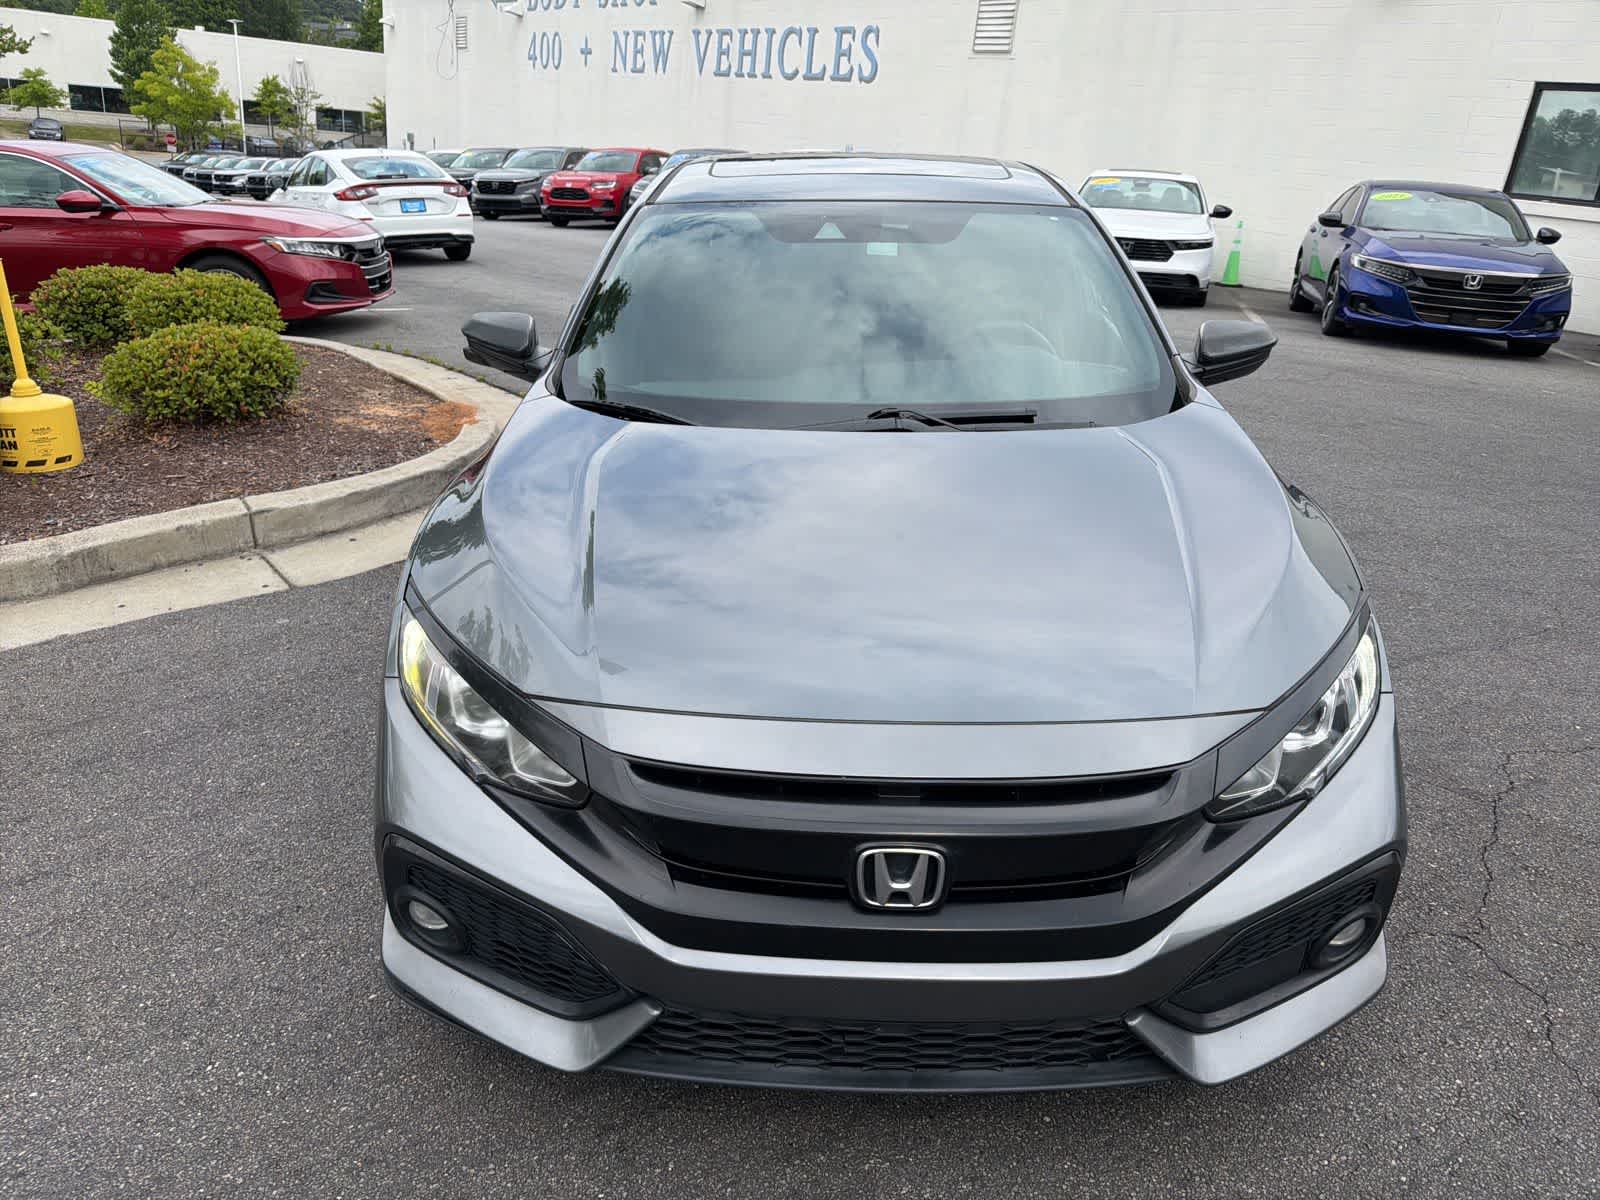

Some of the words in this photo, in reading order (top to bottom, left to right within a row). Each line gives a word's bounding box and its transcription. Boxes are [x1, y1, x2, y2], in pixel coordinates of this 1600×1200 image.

[527, 31, 562, 70] 400
[611, 30, 673, 74] NEW
[692, 25, 880, 84] VEHICLES
